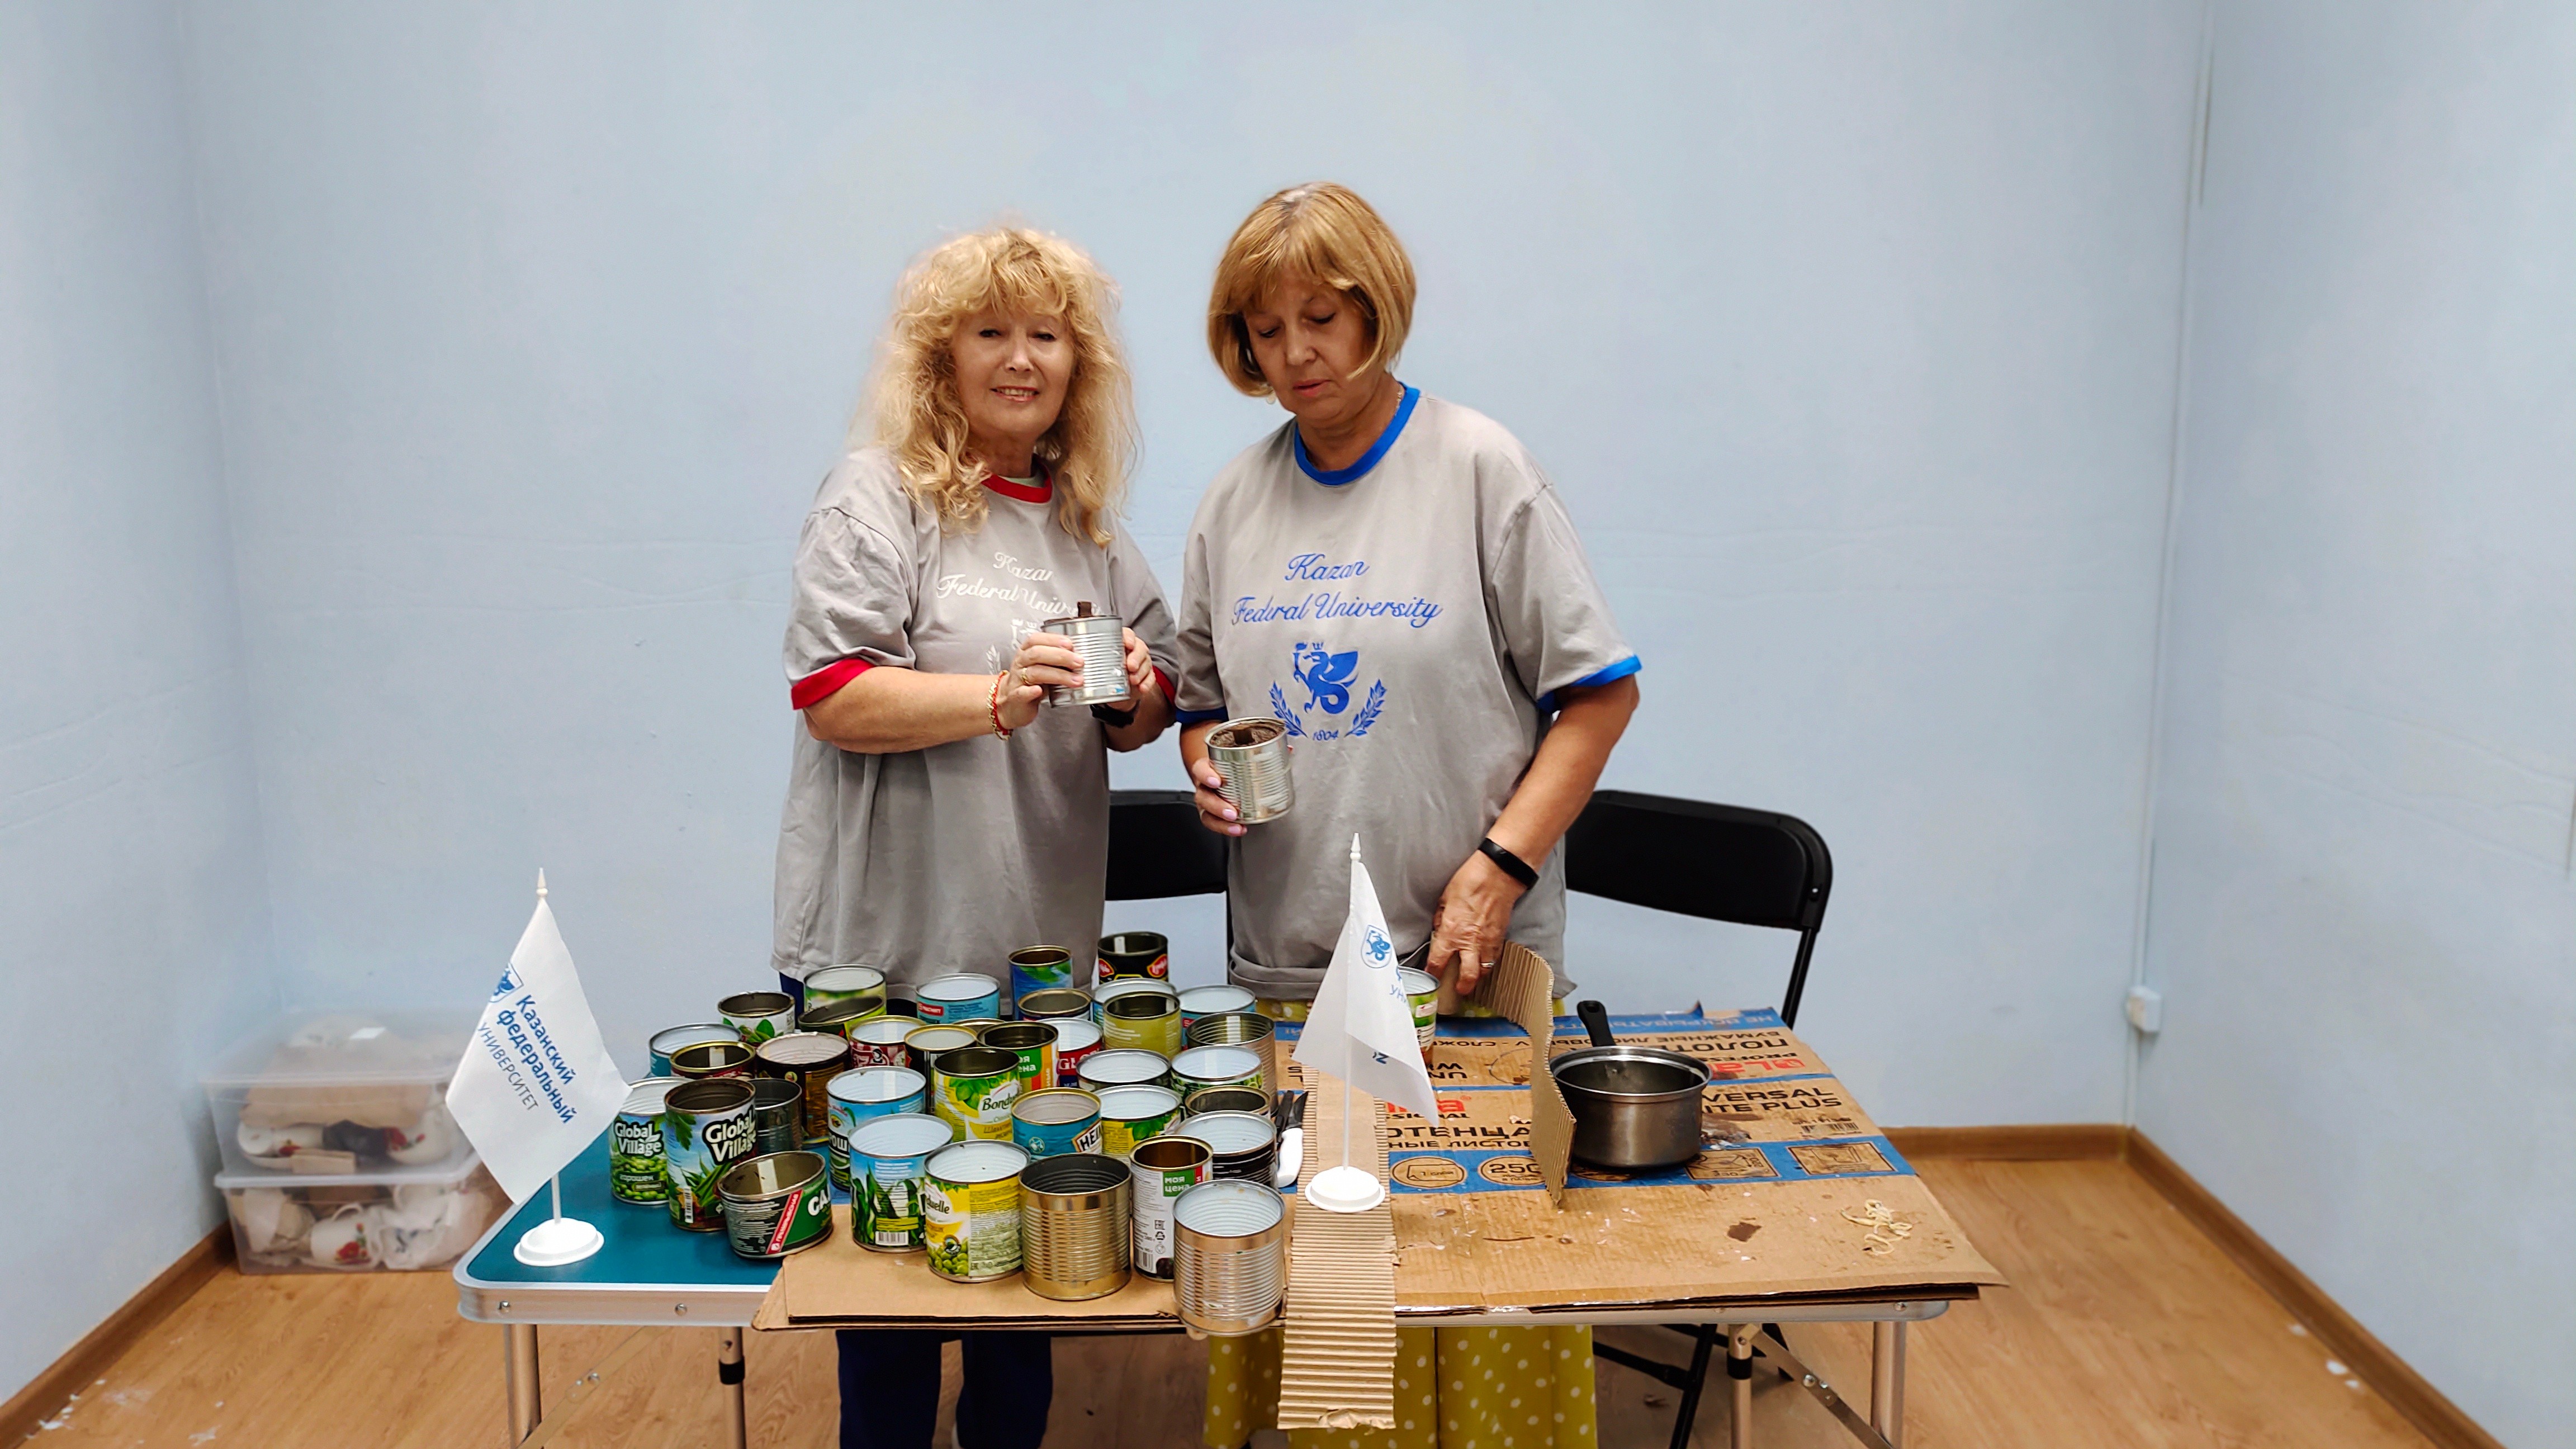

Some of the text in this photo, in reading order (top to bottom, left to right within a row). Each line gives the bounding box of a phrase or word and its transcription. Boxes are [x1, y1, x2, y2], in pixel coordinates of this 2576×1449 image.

[936, 574, 1020, 602] Federal
[1315, 591, 1443, 628] University
[516, 994, 576, 1085] Казанский
[1656, 1031, 1781, 1043] БУМАЖНЫЕ
[478, 1022, 539, 1111] УНИВЕРСИТЕТ
[497, 1009, 577, 1124] федеральный
[1018, 1064, 1036, 1073] ена
[1702, 1088, 1834, 1102] VERSAL
[1703, 1098, 1842, 1114] ITE PLUS
[615, 1123, 654, 1138] Global
[705, 1110, 754, 1143] Global
[1386, 1126, 1530, 1139] ОТЕНЦА
[618, 1137, 662, 1157] Village
[1164, 1176, 1185, 1184] моя
